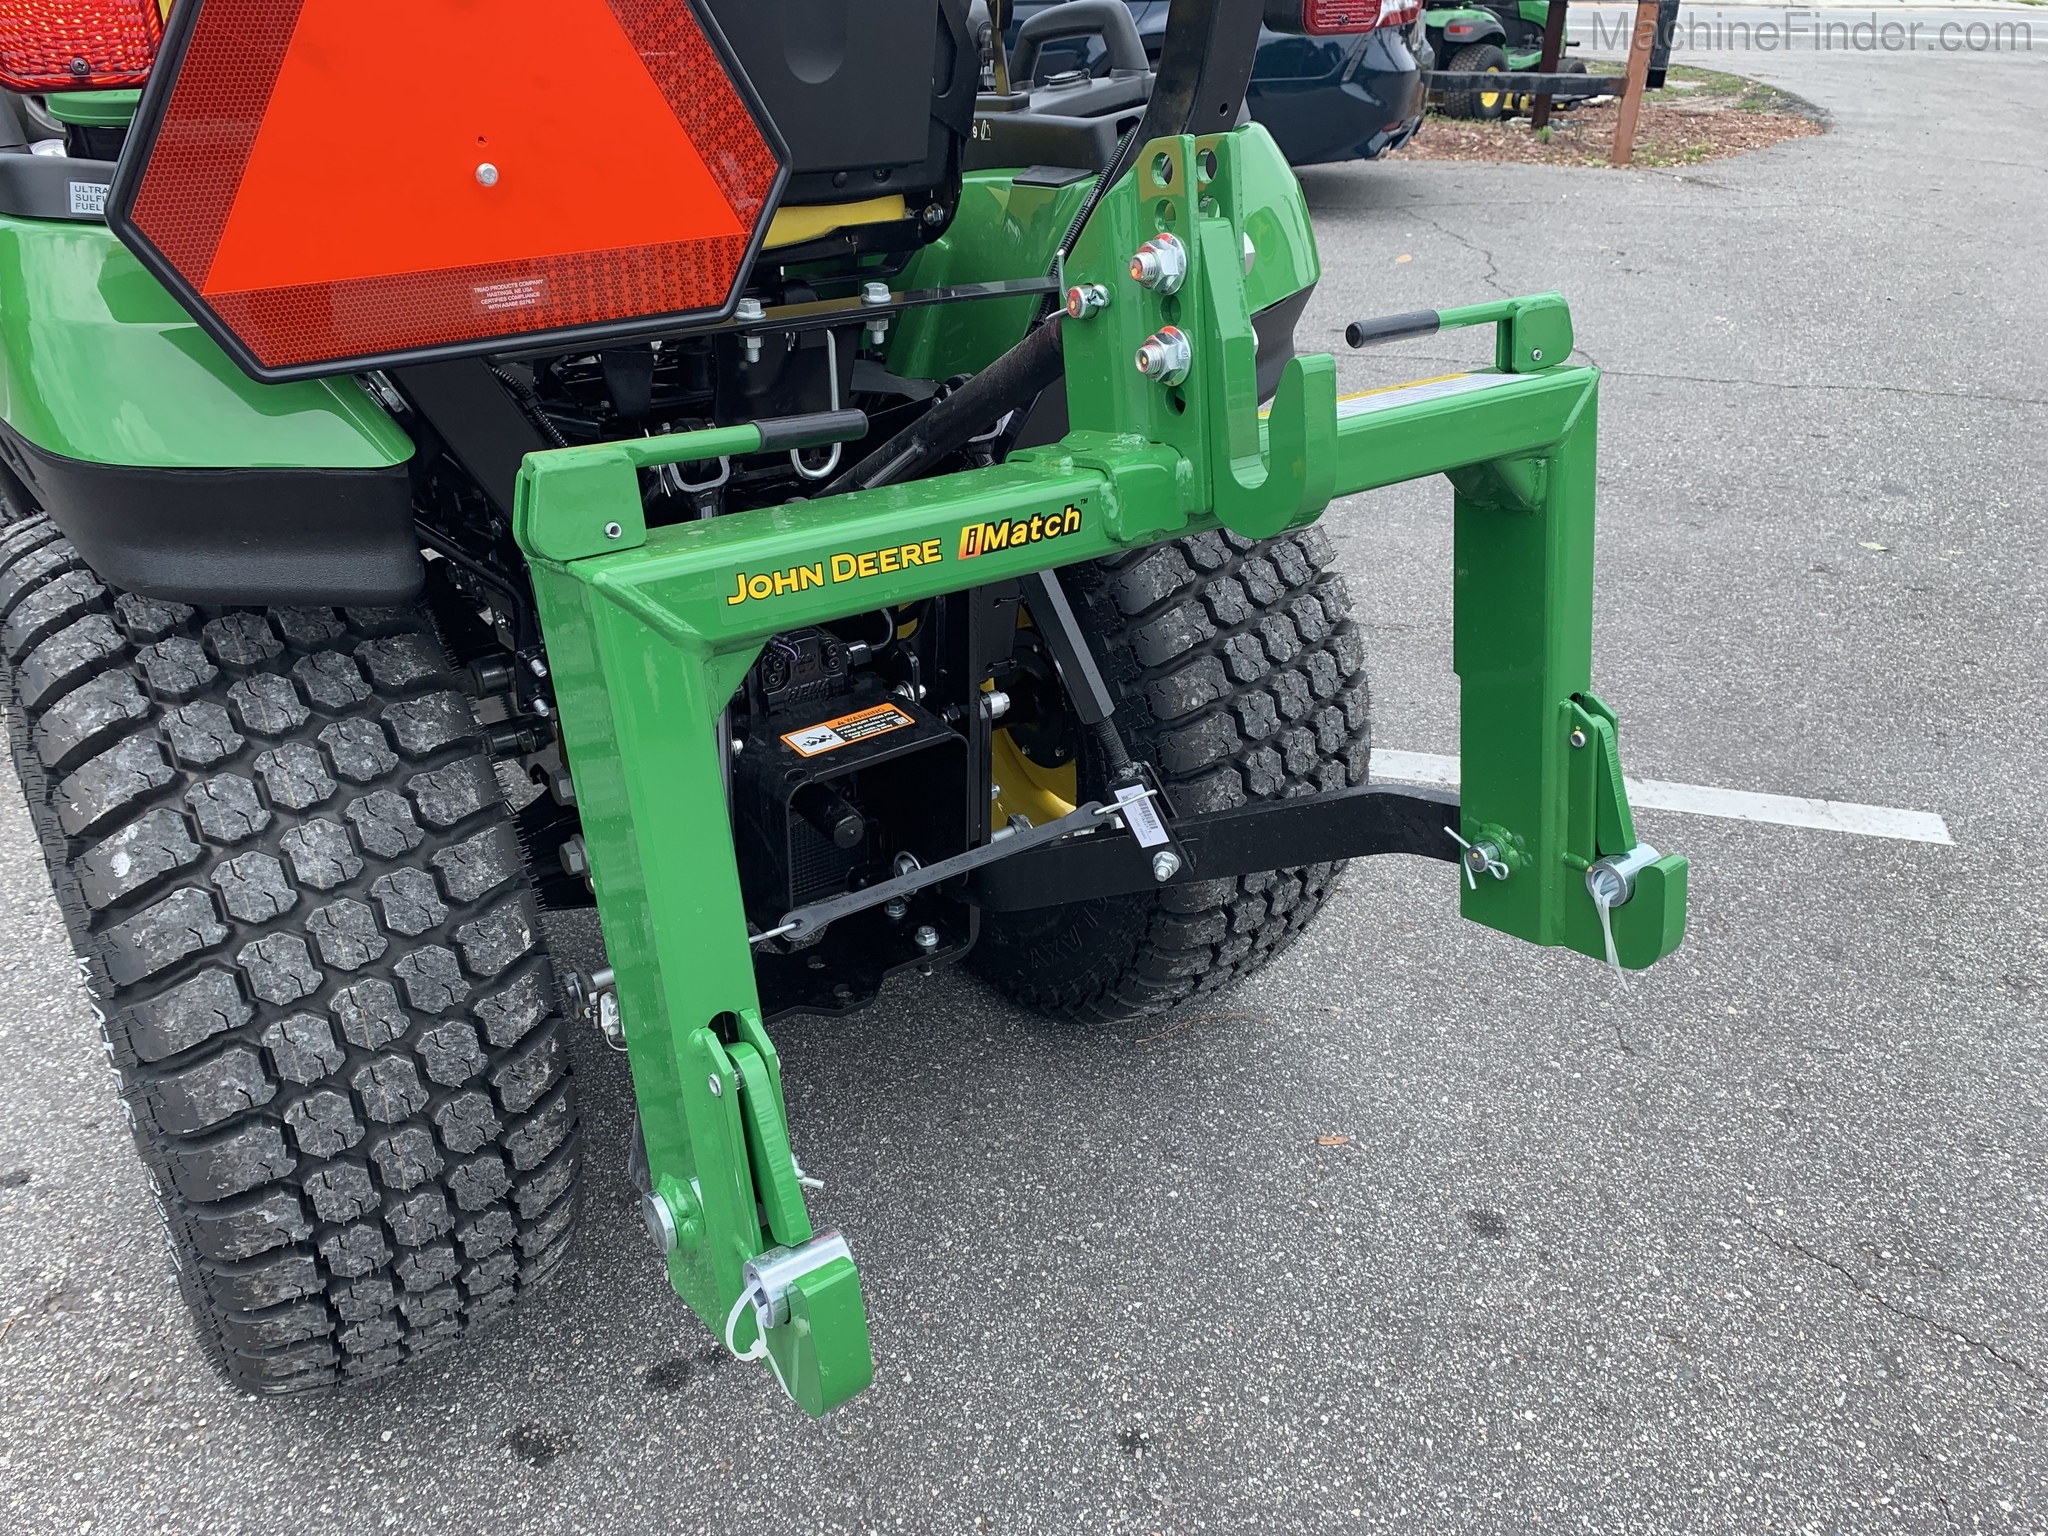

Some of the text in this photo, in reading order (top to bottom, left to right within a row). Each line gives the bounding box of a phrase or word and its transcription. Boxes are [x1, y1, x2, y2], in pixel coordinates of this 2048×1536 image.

[74, 185, 109, 194] ULTRA
[75, 203, 102, 211] FUEL
[489, 282, 518, 291] PRODUCTS
[518, 279, 544, 287] COMPANY
[480, 292, 541, 305] CERTIFIES COMPLIANCE
[727, 563, 824, 606] JOHN
[830, 537, 943, 583] DEERE
[958, 504, 1082, 560] iMatch
[844, 708, 885, 722] WARNING
